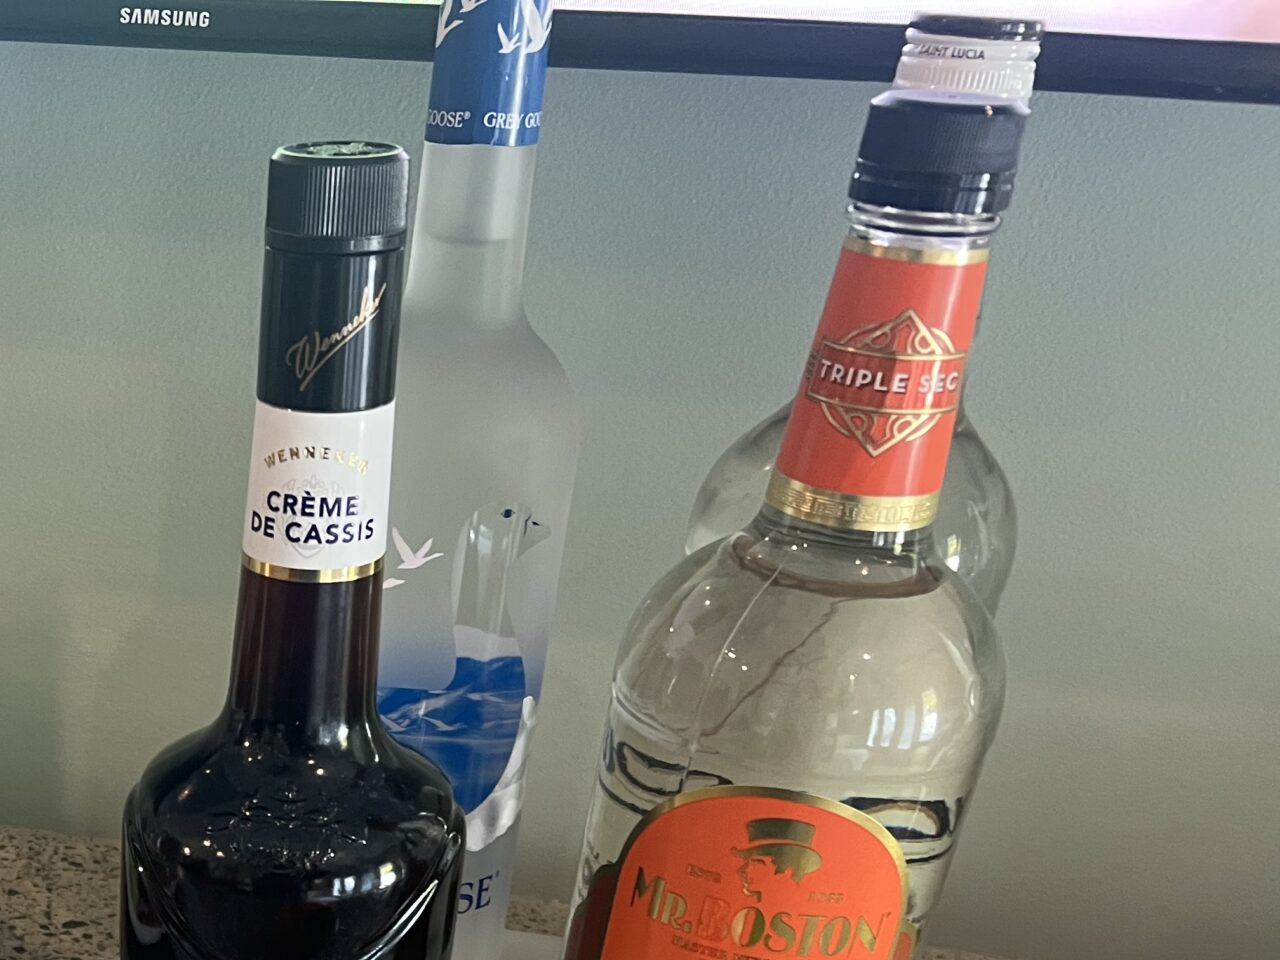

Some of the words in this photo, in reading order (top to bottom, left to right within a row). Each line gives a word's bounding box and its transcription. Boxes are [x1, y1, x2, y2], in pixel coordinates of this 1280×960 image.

[120, 7, 210, 28] SAMSUNG
[951, 47, 985, 60] LUCIA
[483, 111, 524, 129] GREY
[820, 359, 909, 393] TRIPLE
[918, 371, 960, 394] SEC
[263, 446, 369, 475] WENNEKER
[266, 490, 360, 517] CRÈME
[251, 510, 275, 538] DE
[284, 518, 374, 545] CASSIS
[695, 895, 886, 958] BOSTON
